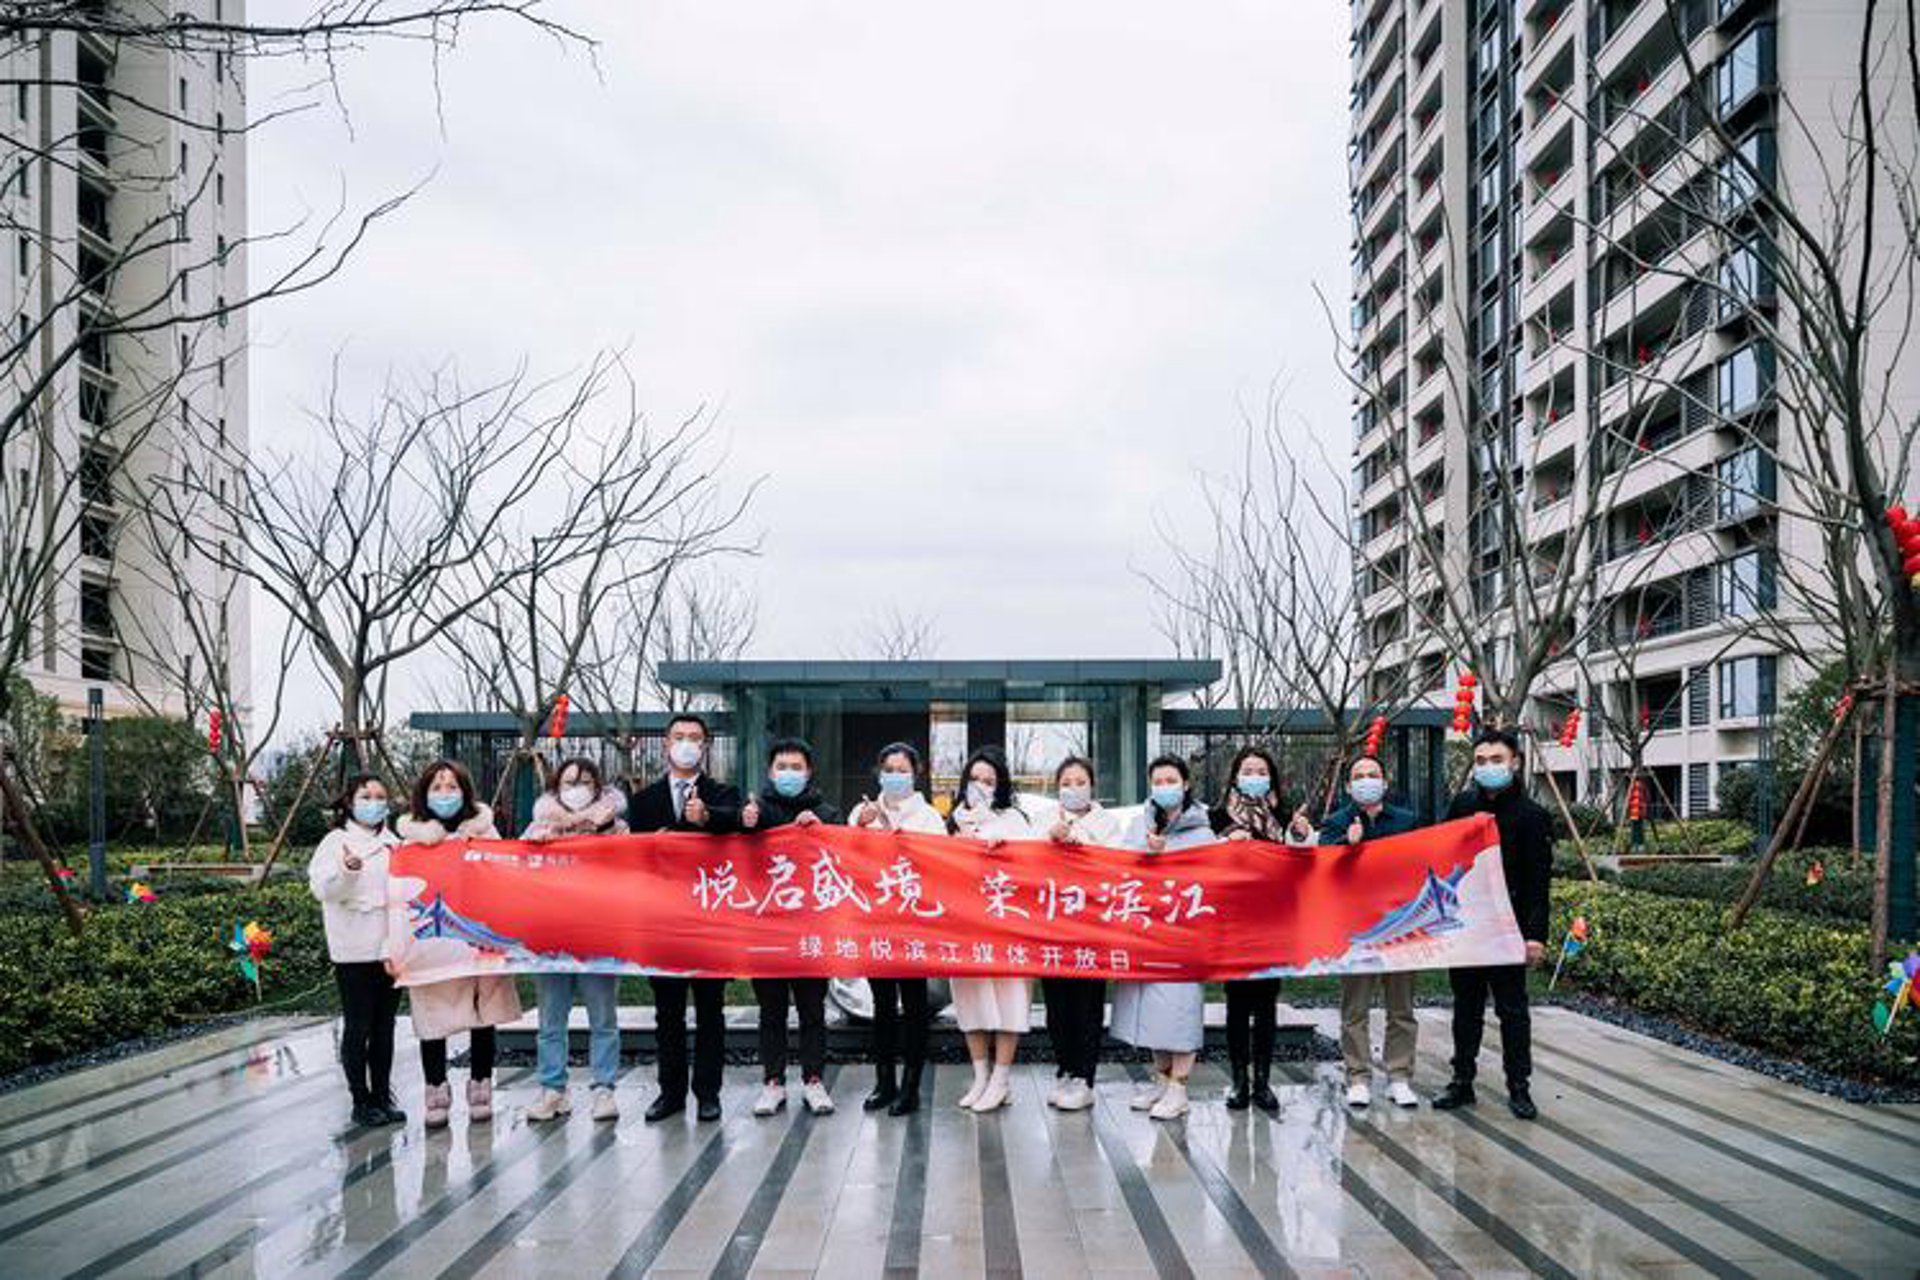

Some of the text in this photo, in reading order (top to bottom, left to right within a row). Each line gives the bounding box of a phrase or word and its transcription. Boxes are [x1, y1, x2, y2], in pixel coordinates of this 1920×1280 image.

[692, 849, 1216, 928] 悦启盛境 荣归滨江
[798, 936, 1130, 970] 绿地悦滨江媒体开放日
